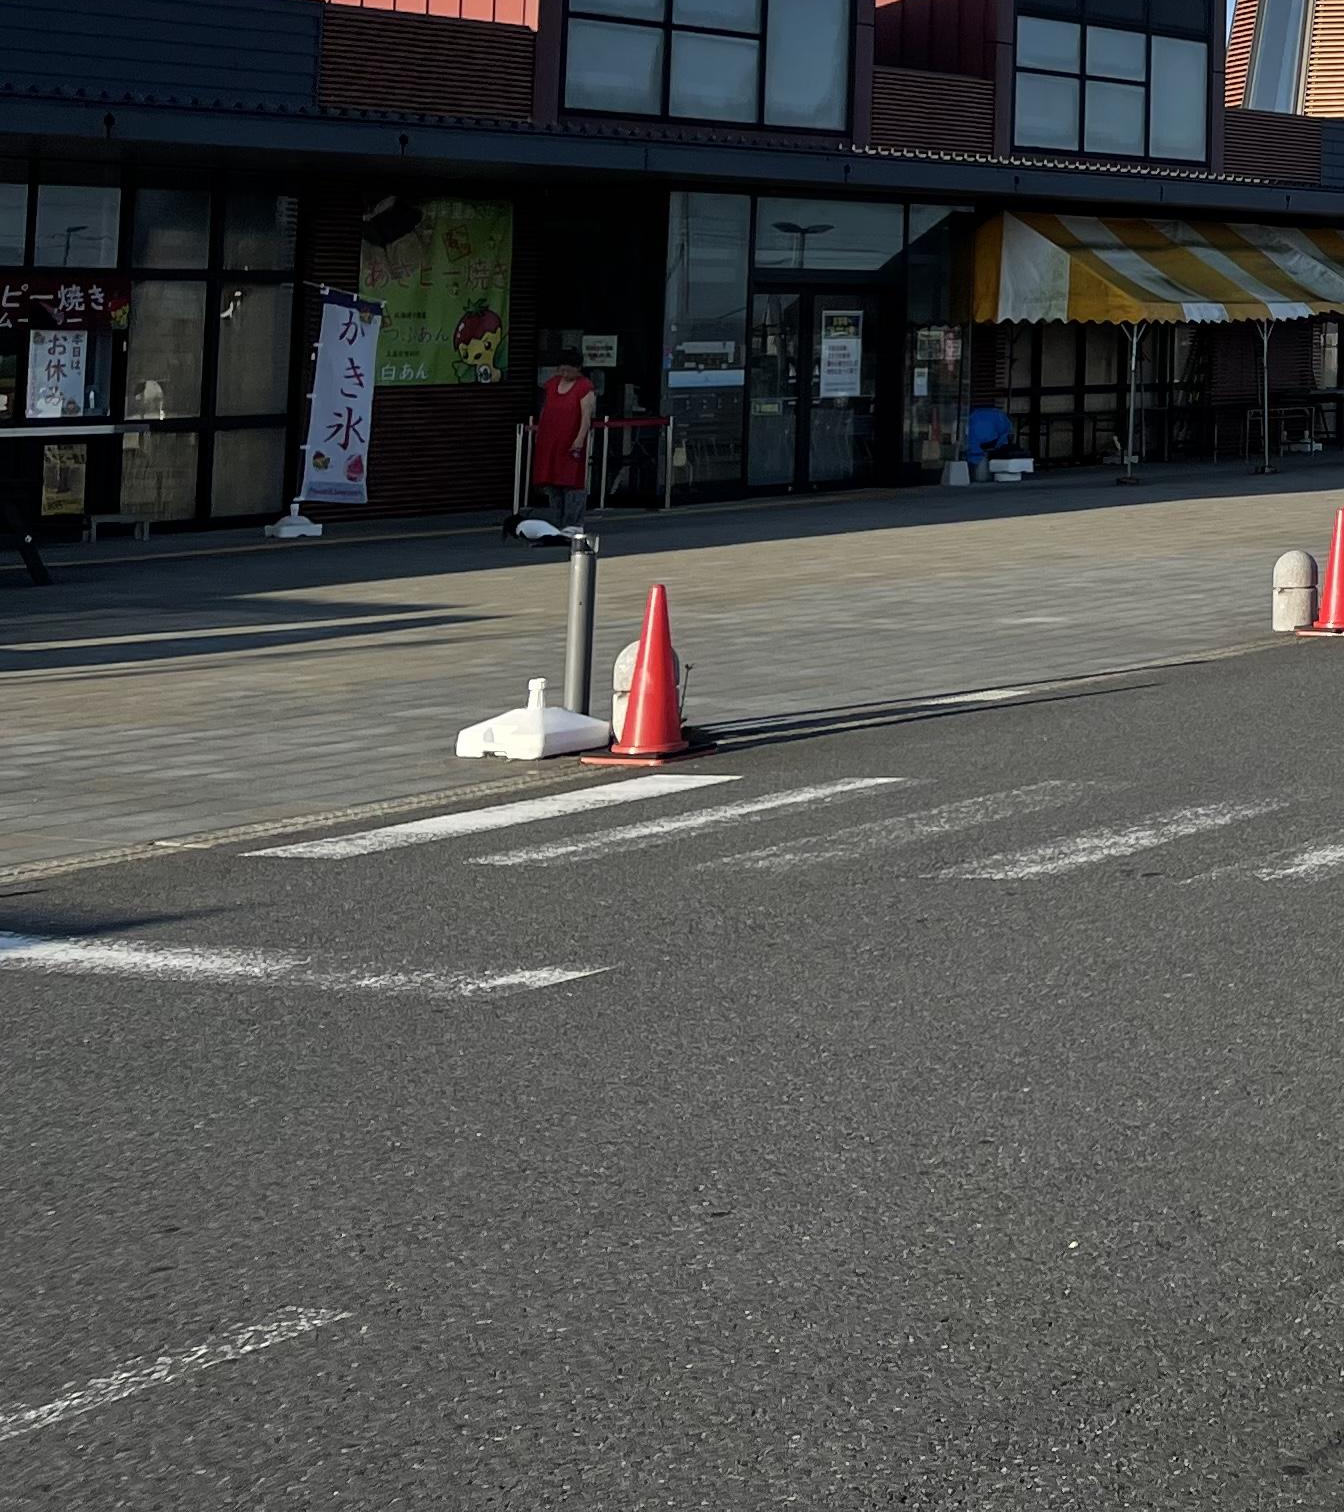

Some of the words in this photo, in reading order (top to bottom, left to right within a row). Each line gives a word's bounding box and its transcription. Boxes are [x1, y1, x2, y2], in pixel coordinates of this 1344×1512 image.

[324, 311, 366, 450] かき氷
[381, 361, 427, 381] 白あん
